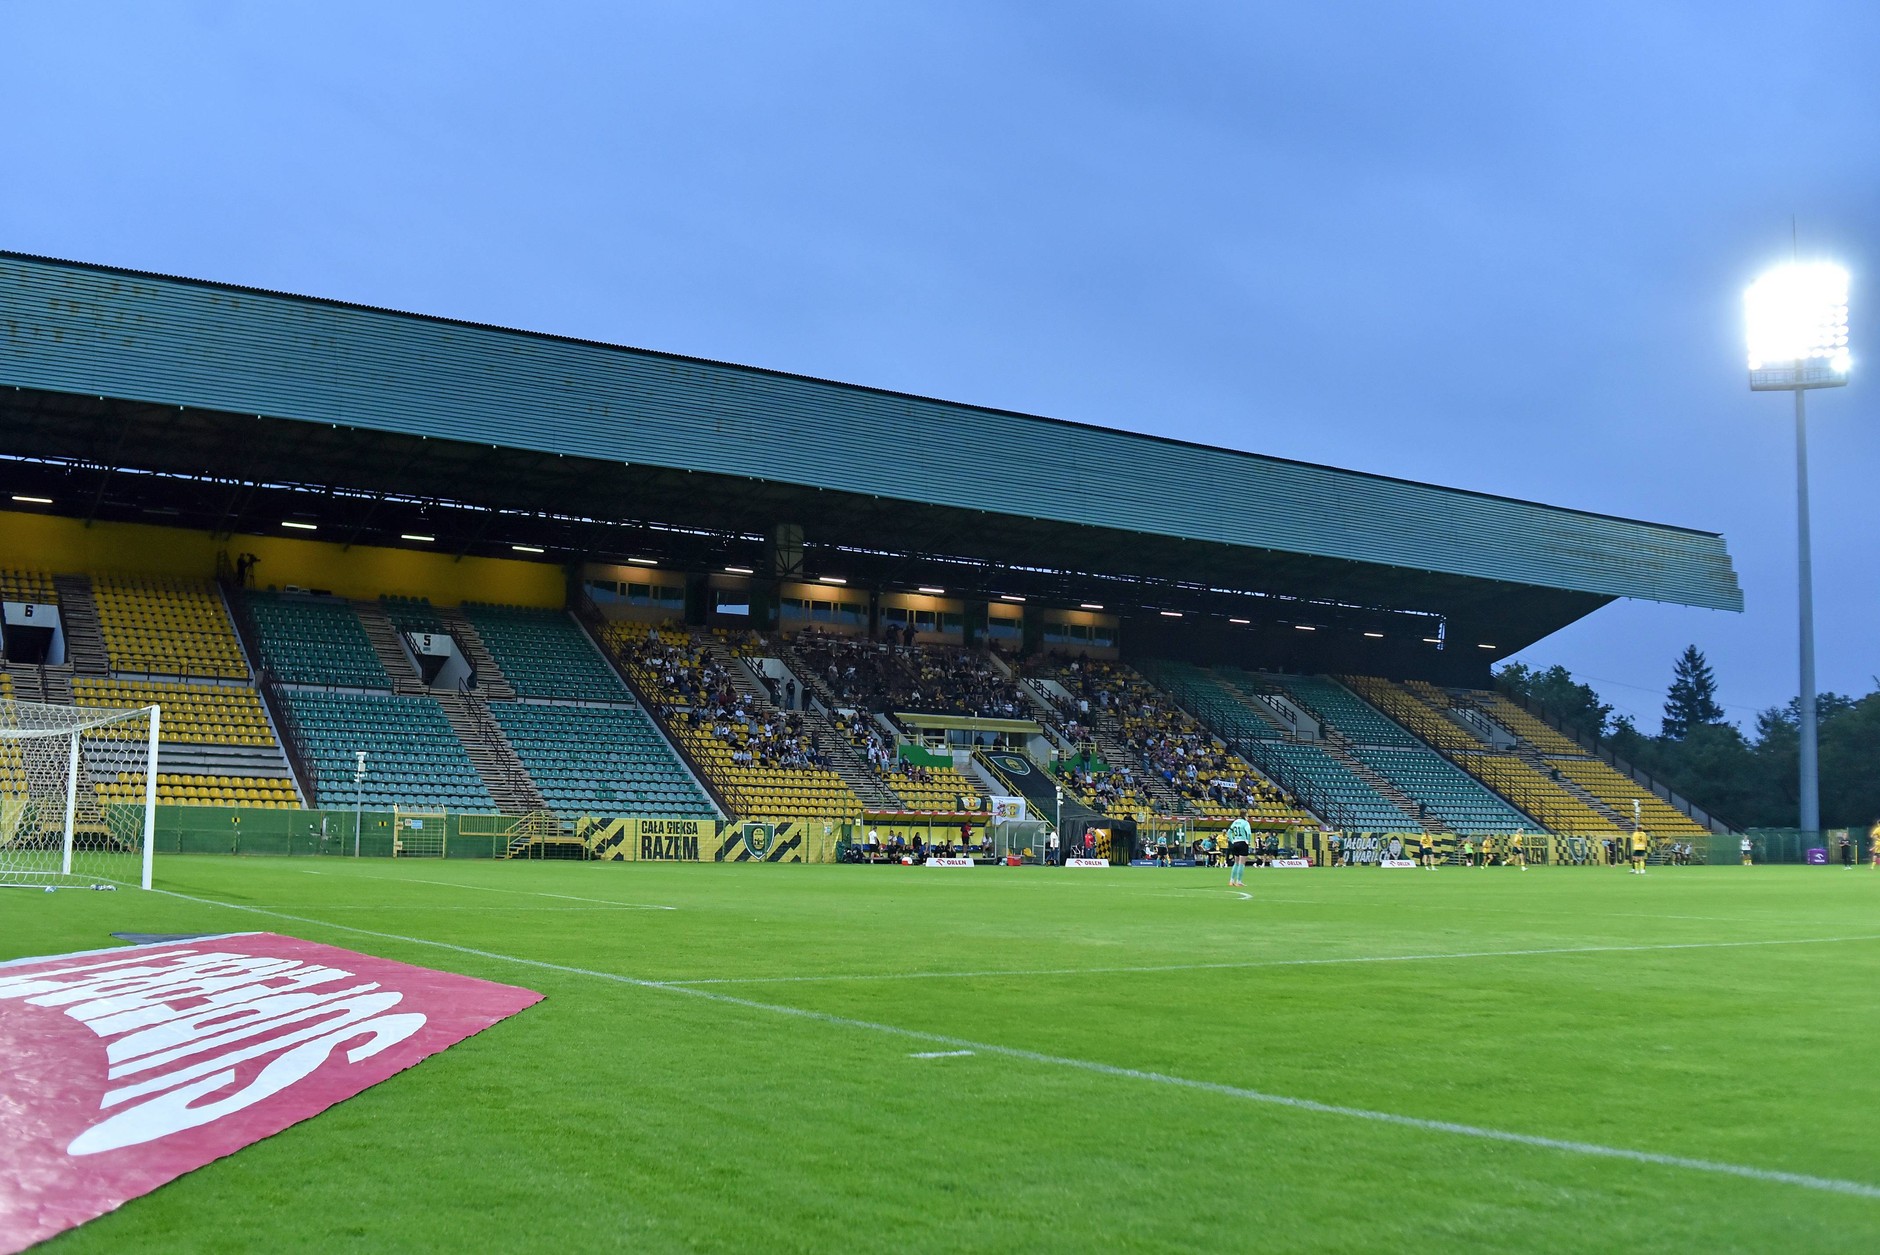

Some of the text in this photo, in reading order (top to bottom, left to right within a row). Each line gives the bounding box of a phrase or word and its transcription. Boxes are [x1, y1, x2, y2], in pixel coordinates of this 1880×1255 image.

[25, 605, 33, 617] 6
[424, 635, 431, 646] 5
[641, 821, 665, 834] CAŁA
[1234, 826, 1242, 837] 31
[641, 836, 698, 860] RAZEM
[0, 950, 426, 1156] SUPERBET
